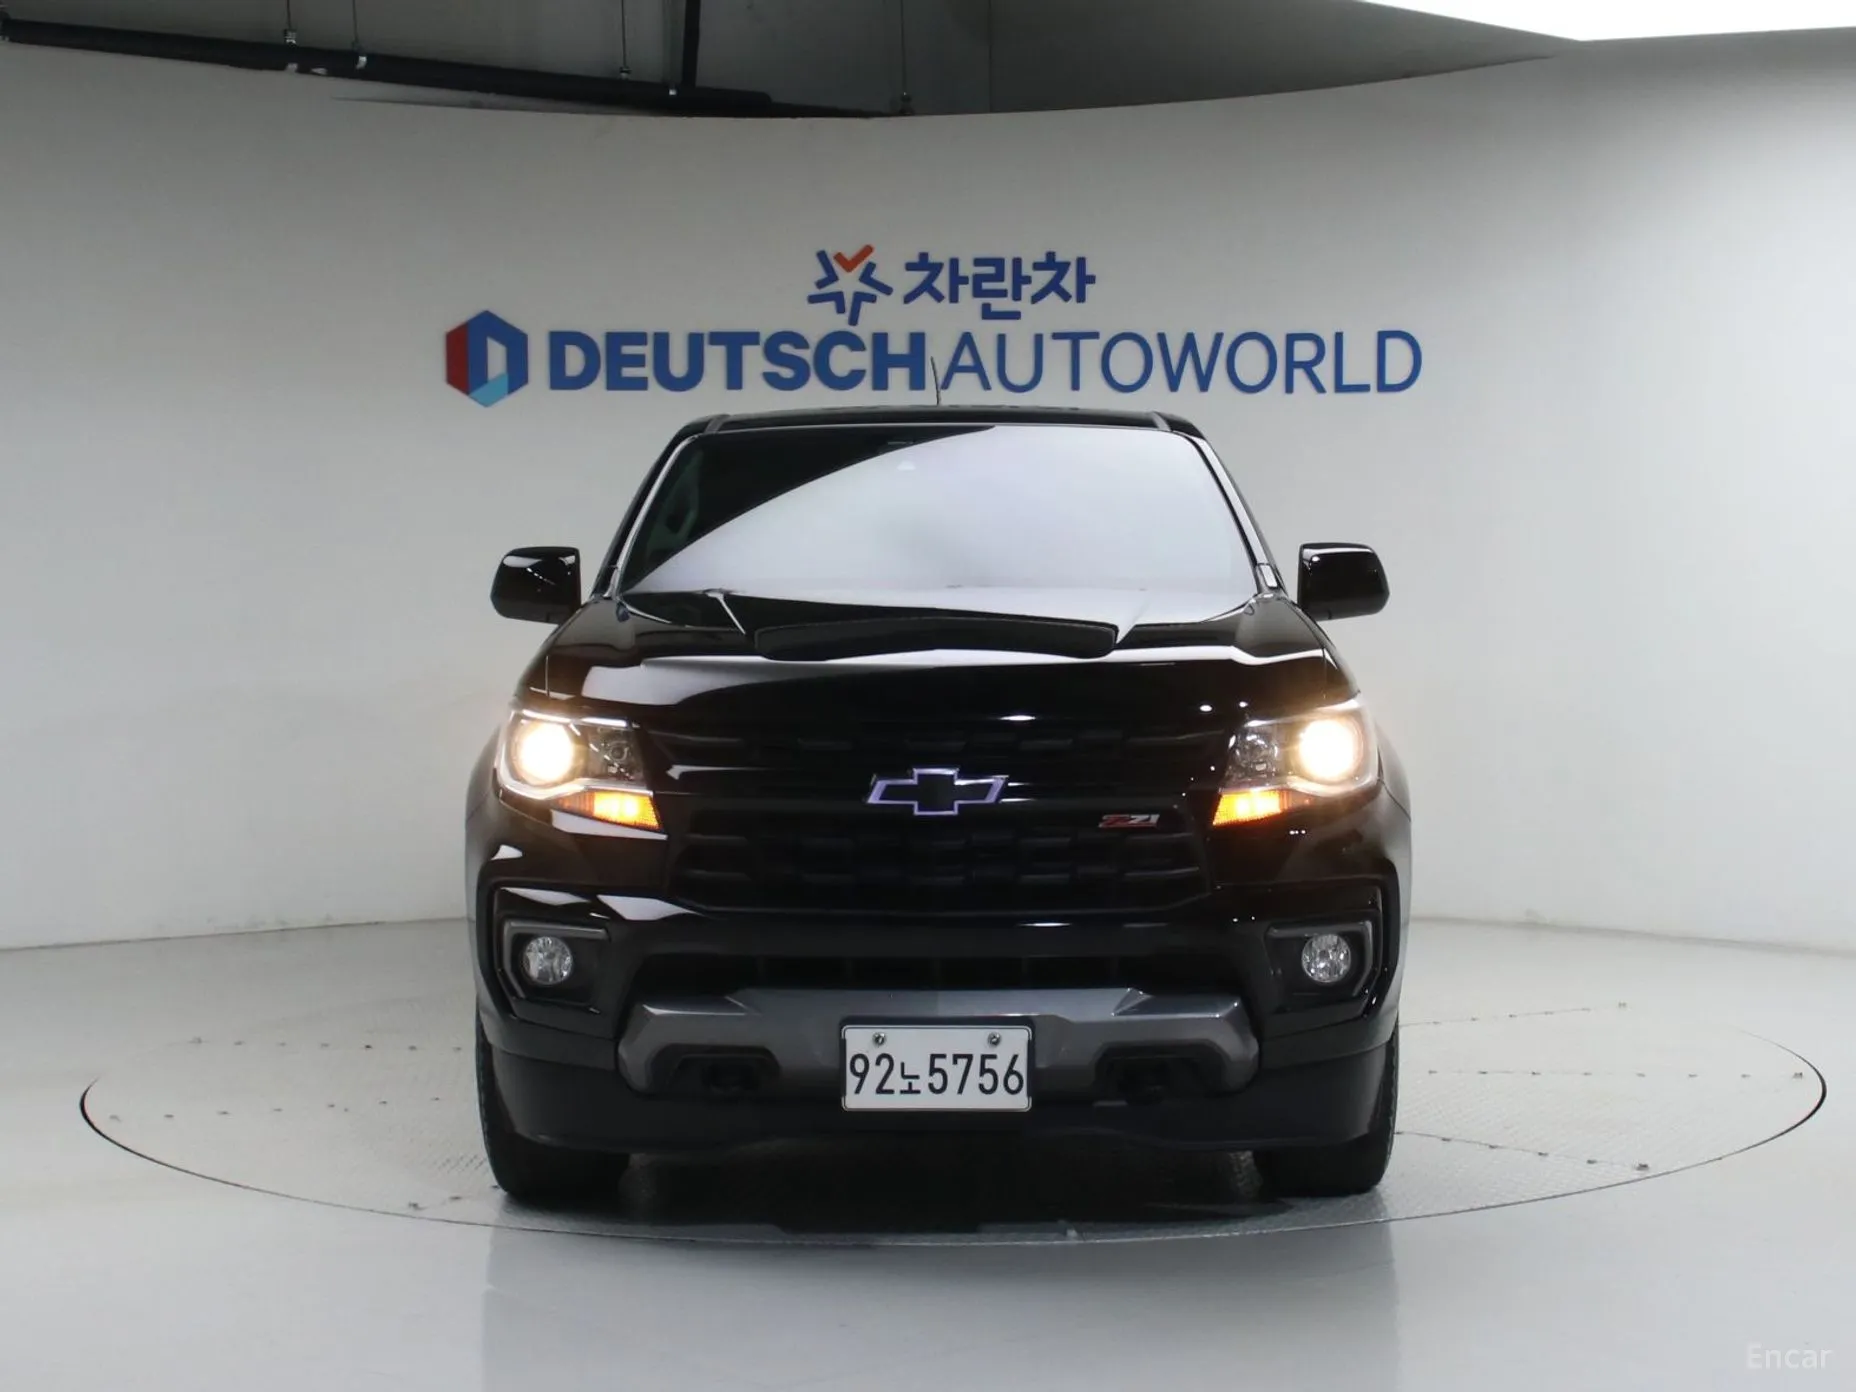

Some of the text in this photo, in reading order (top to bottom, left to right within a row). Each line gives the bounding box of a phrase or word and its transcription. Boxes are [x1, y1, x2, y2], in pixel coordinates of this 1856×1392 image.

[903, 251, 1096, 321] 차란차
[548, 330, 1423, 394] DEUTSCH AUTOWORLD
[849, 1052, 1025, 1096] 92노5756
